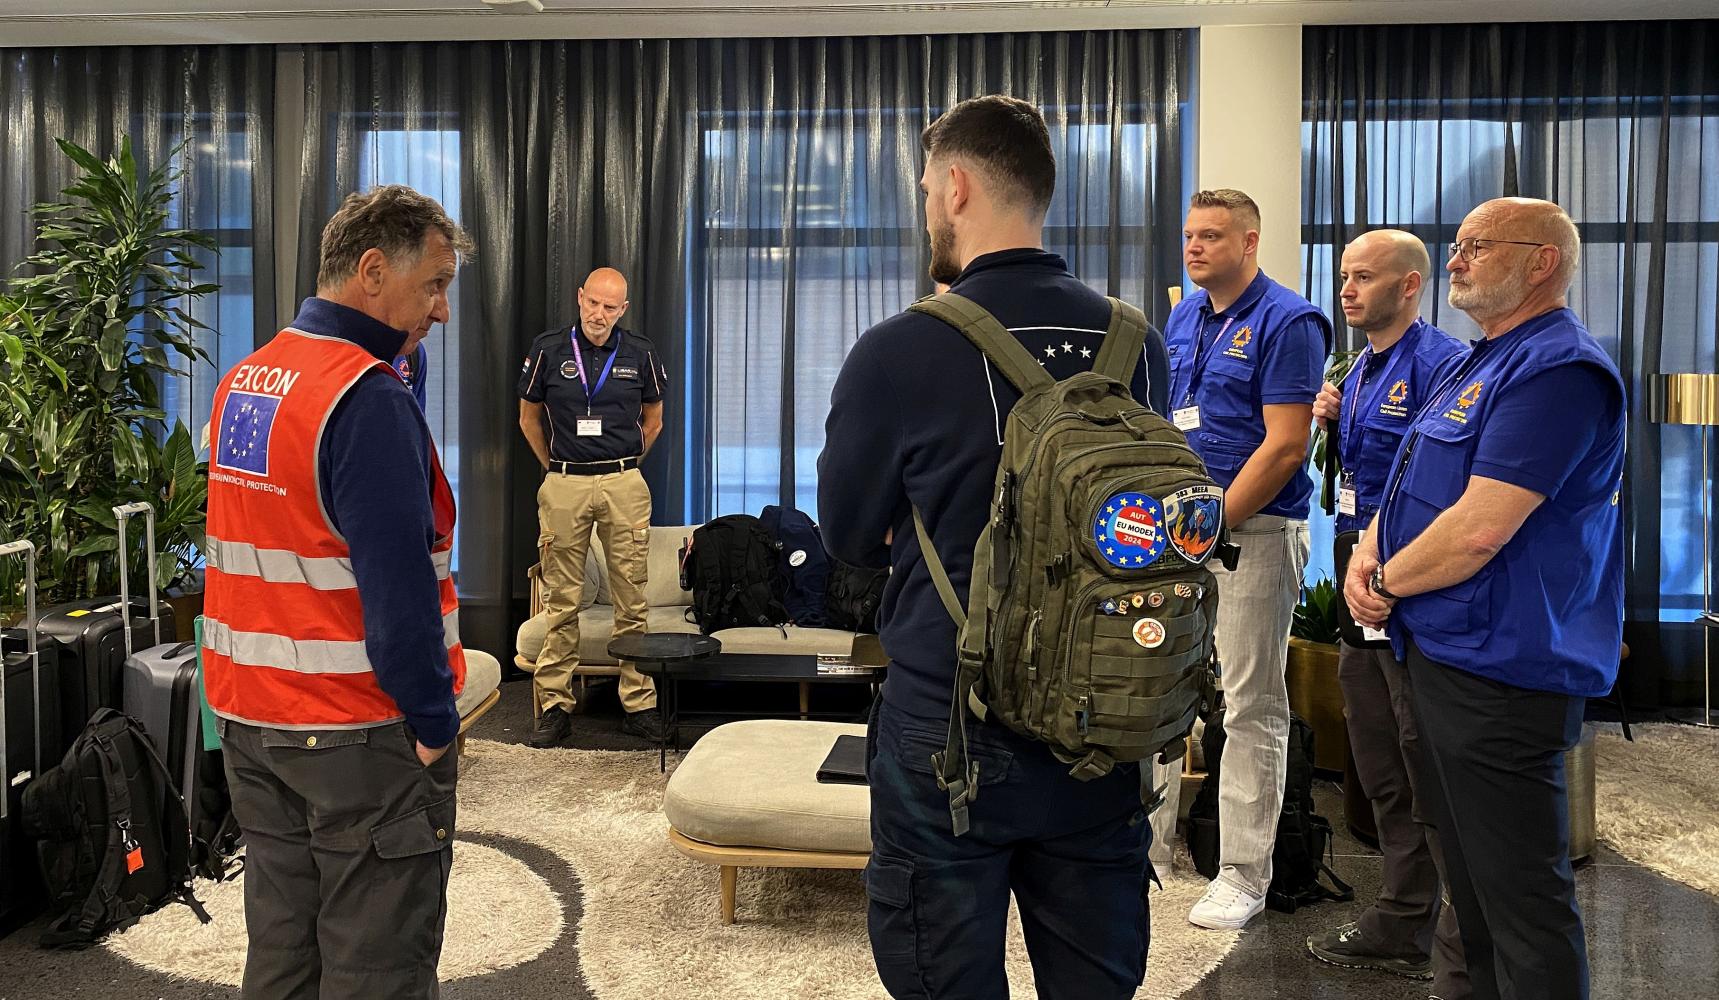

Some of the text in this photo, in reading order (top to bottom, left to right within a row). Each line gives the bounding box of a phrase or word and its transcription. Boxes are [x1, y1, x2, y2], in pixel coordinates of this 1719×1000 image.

[230, 365, 300, 395] EXCON
[247, 481, 287, 496] PROTECTON
[1130, 511, 1146, 520] AUT
[1116, 521, 1155, 537] EU MODEX
[1123, 535, 1142, 545] 2024
